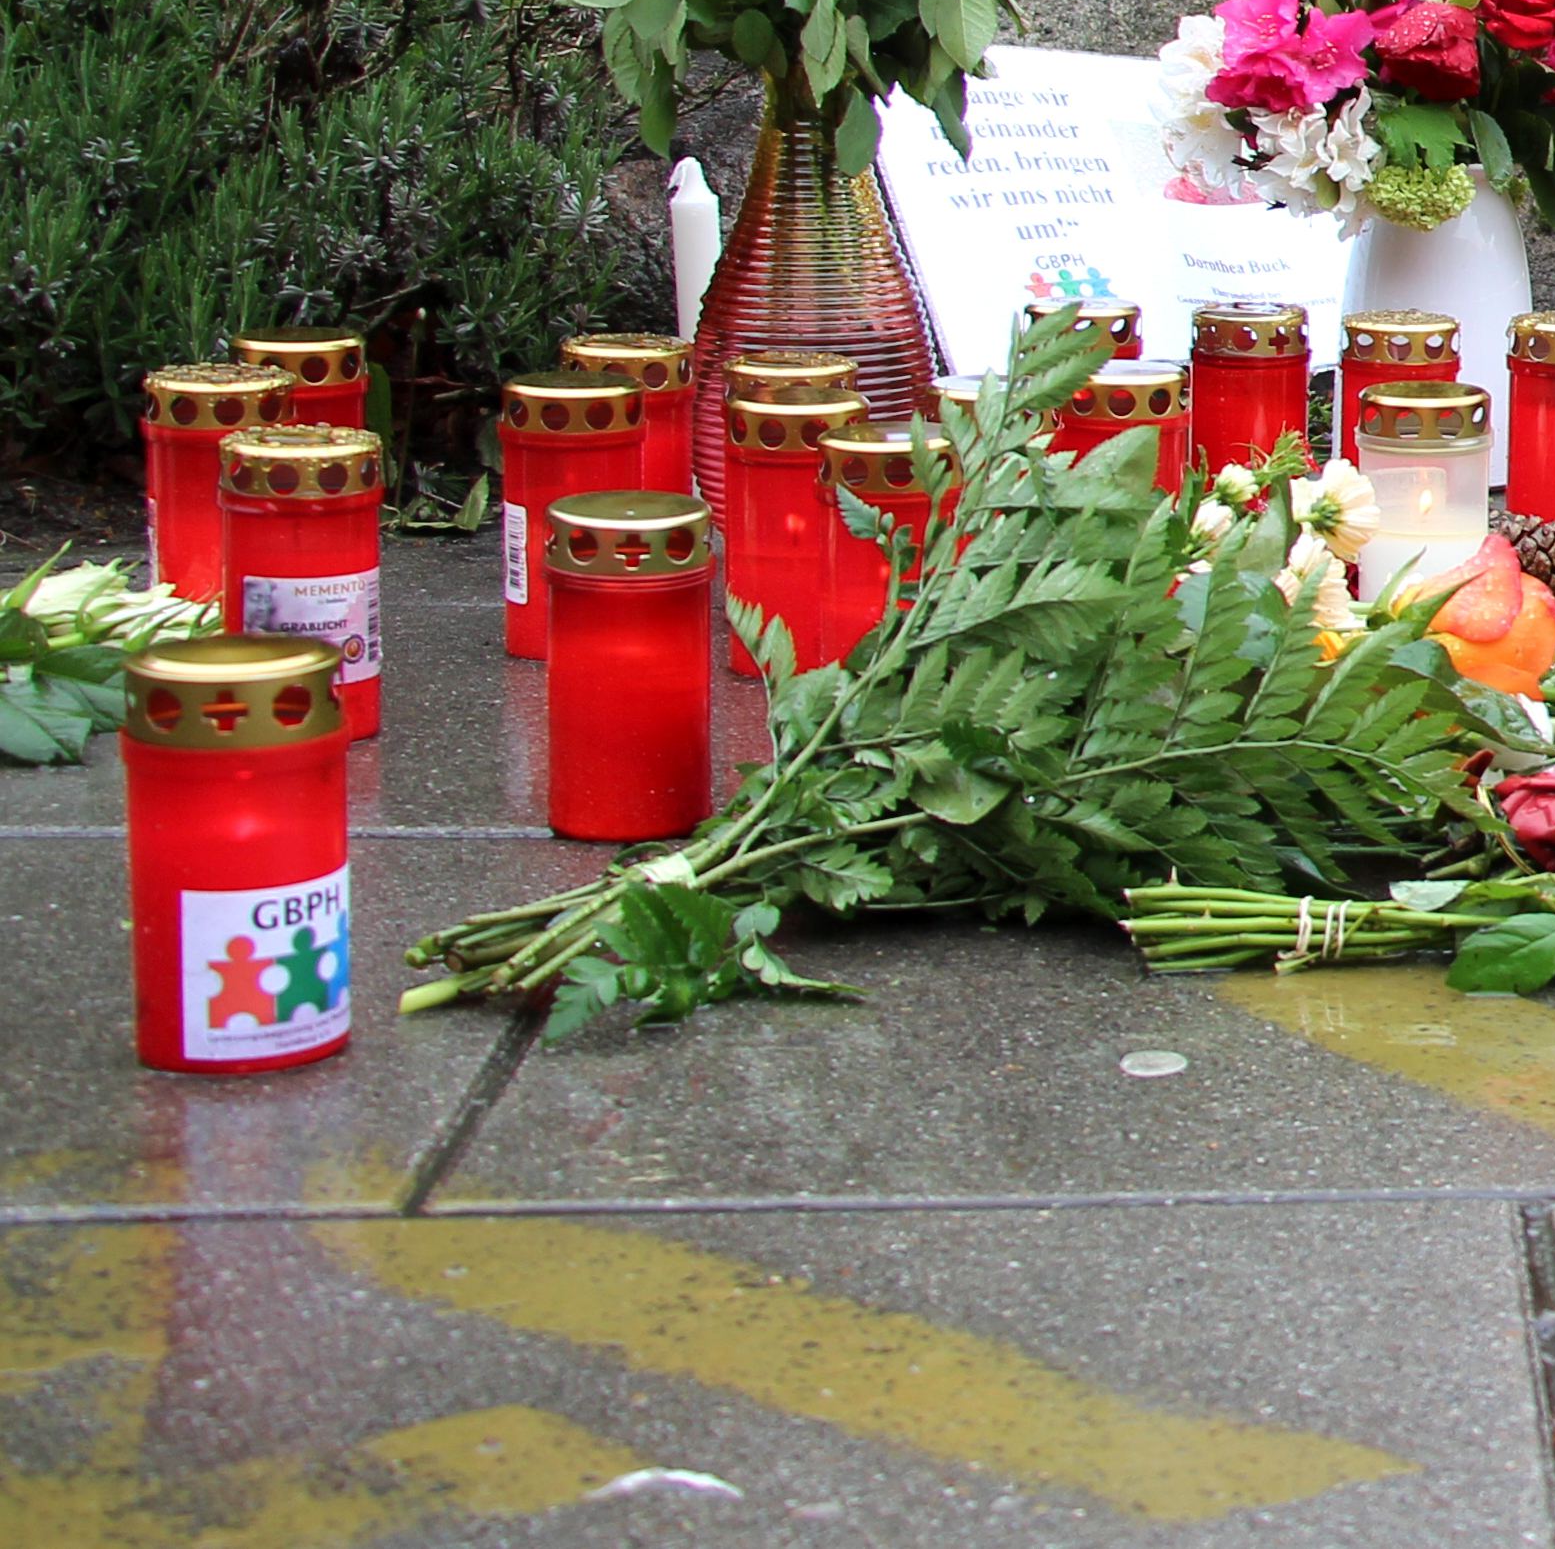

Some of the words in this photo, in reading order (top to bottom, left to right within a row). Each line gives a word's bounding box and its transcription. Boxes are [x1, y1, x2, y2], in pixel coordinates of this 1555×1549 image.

[968, 89, 1024, 108] ange
[1032, 87, 1069, 107] wir
[1014, 151, 1110, 174] bringen
[950, 187, 993, 210] wir
[1001, 189, 1048, 206] uns
[1055, 184, 1115, 204] nicht
[1035, 253, 1085, 271] GBPH
[1183, 252, 1245, 275] Dorothea
[1248, 257, 1291, 275] Buck
[294, 580, 366, 597] MEMENTO
[281, 619, 348, 632] GRABLICHT
[252, 883, 340, 929] GBPH
